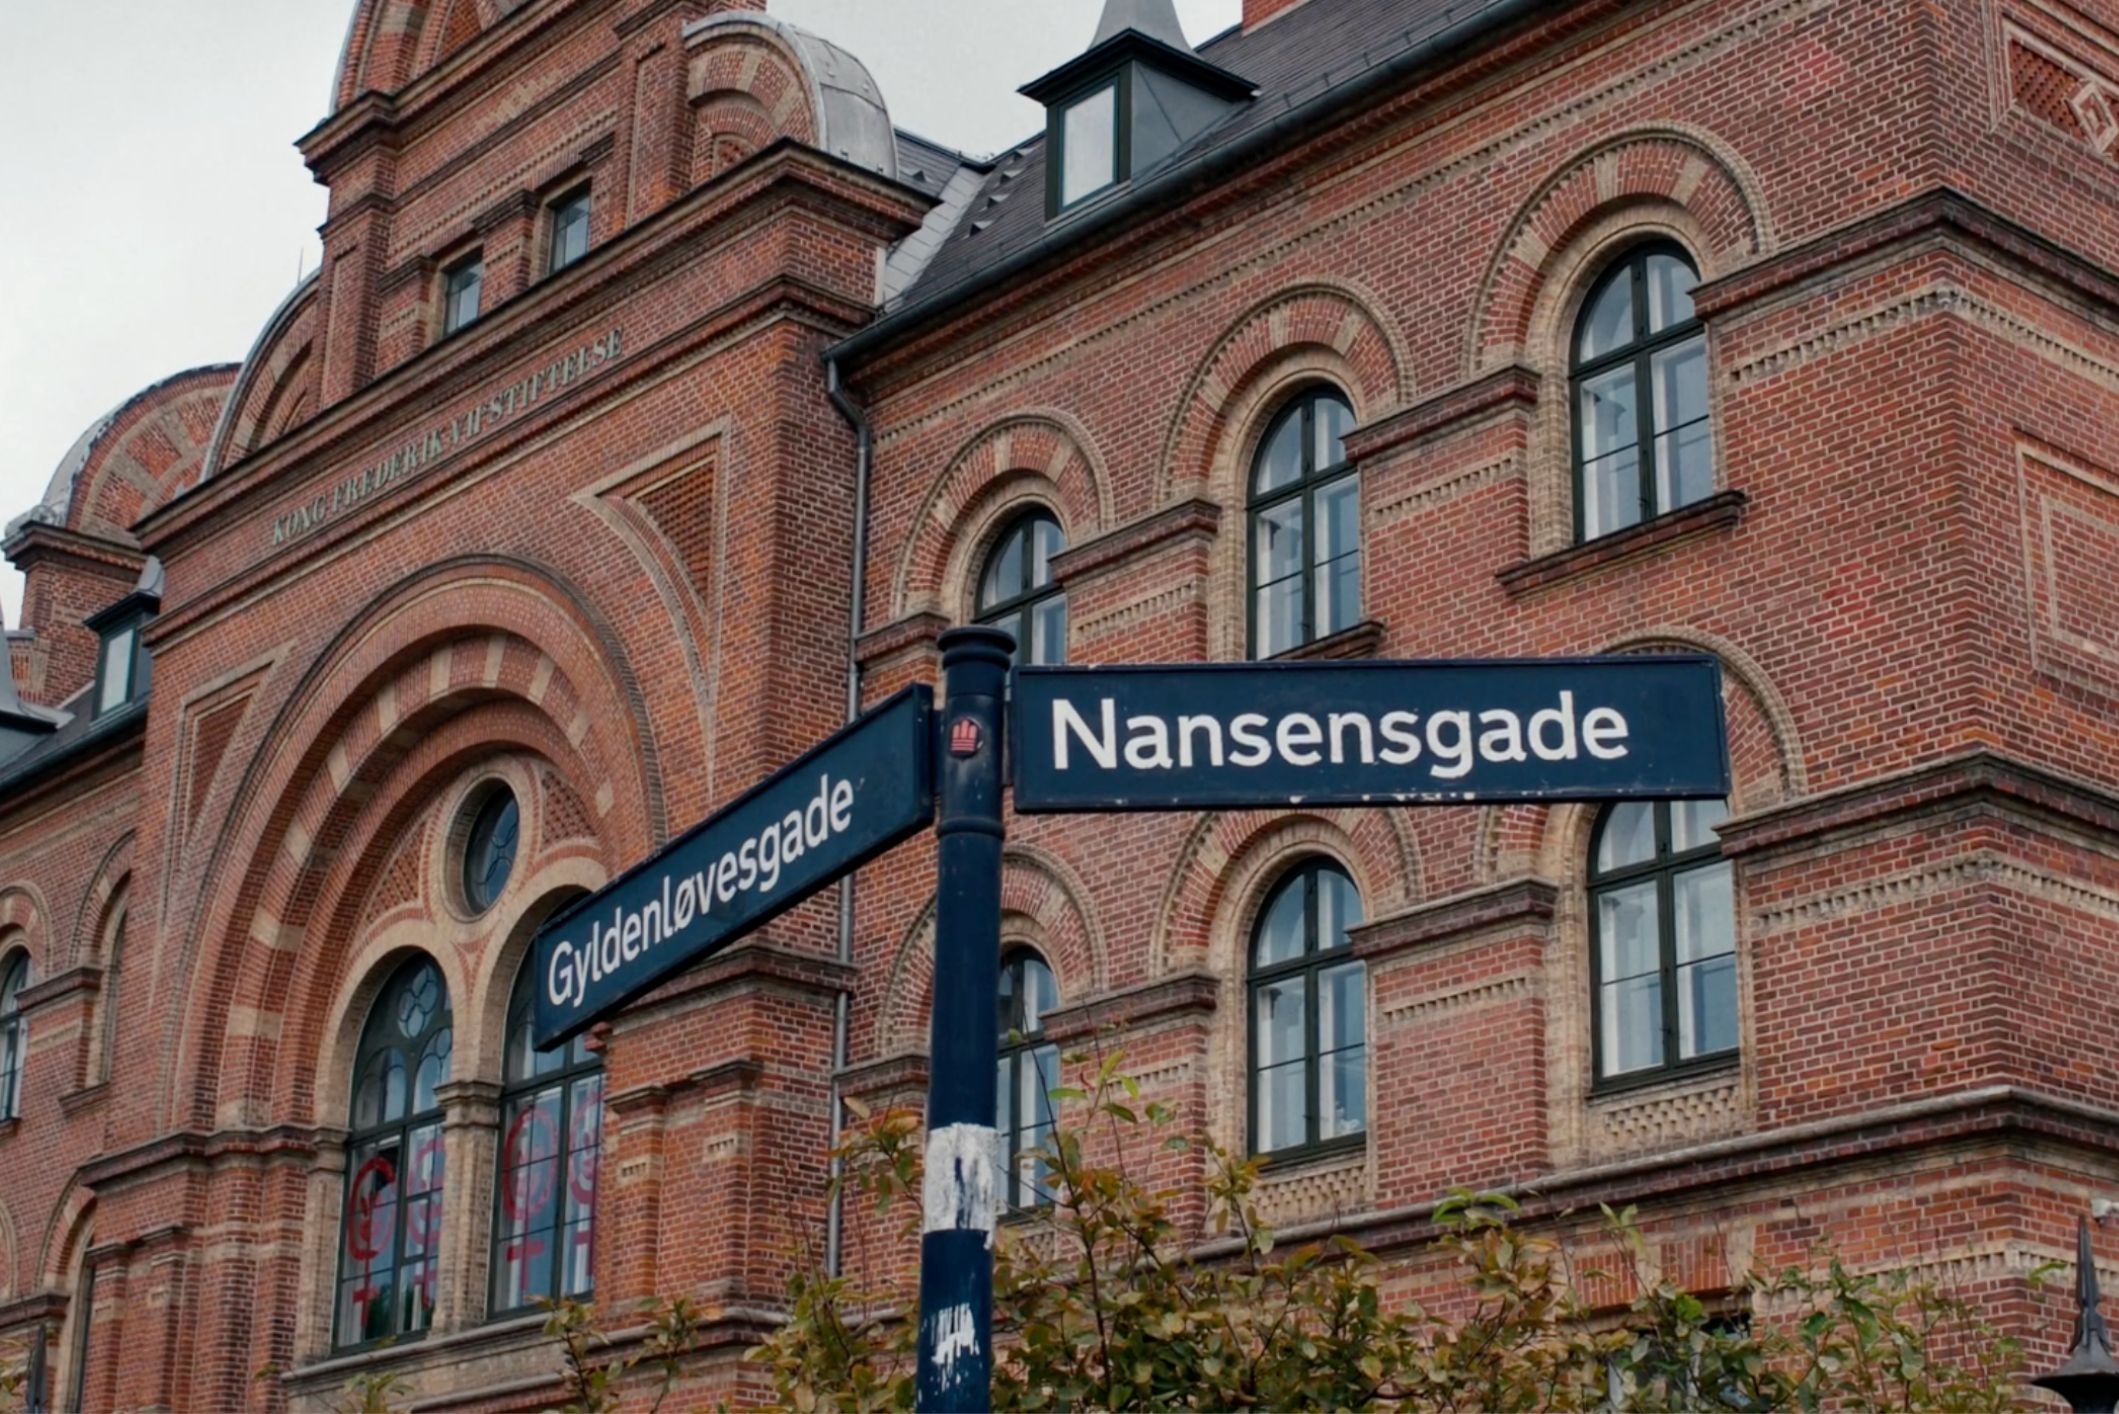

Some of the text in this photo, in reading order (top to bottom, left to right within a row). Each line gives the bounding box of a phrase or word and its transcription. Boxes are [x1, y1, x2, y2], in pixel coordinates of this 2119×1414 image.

[272, 491, 327, 546] KONG
[331, 427, 444, 513] FREDERIK
[487, 324, 623, 423] STIFTELSE
[1052, 690, 1629, 779] Nansensgade
[548, 773, 855, 1008] Gyldenløvesgade
